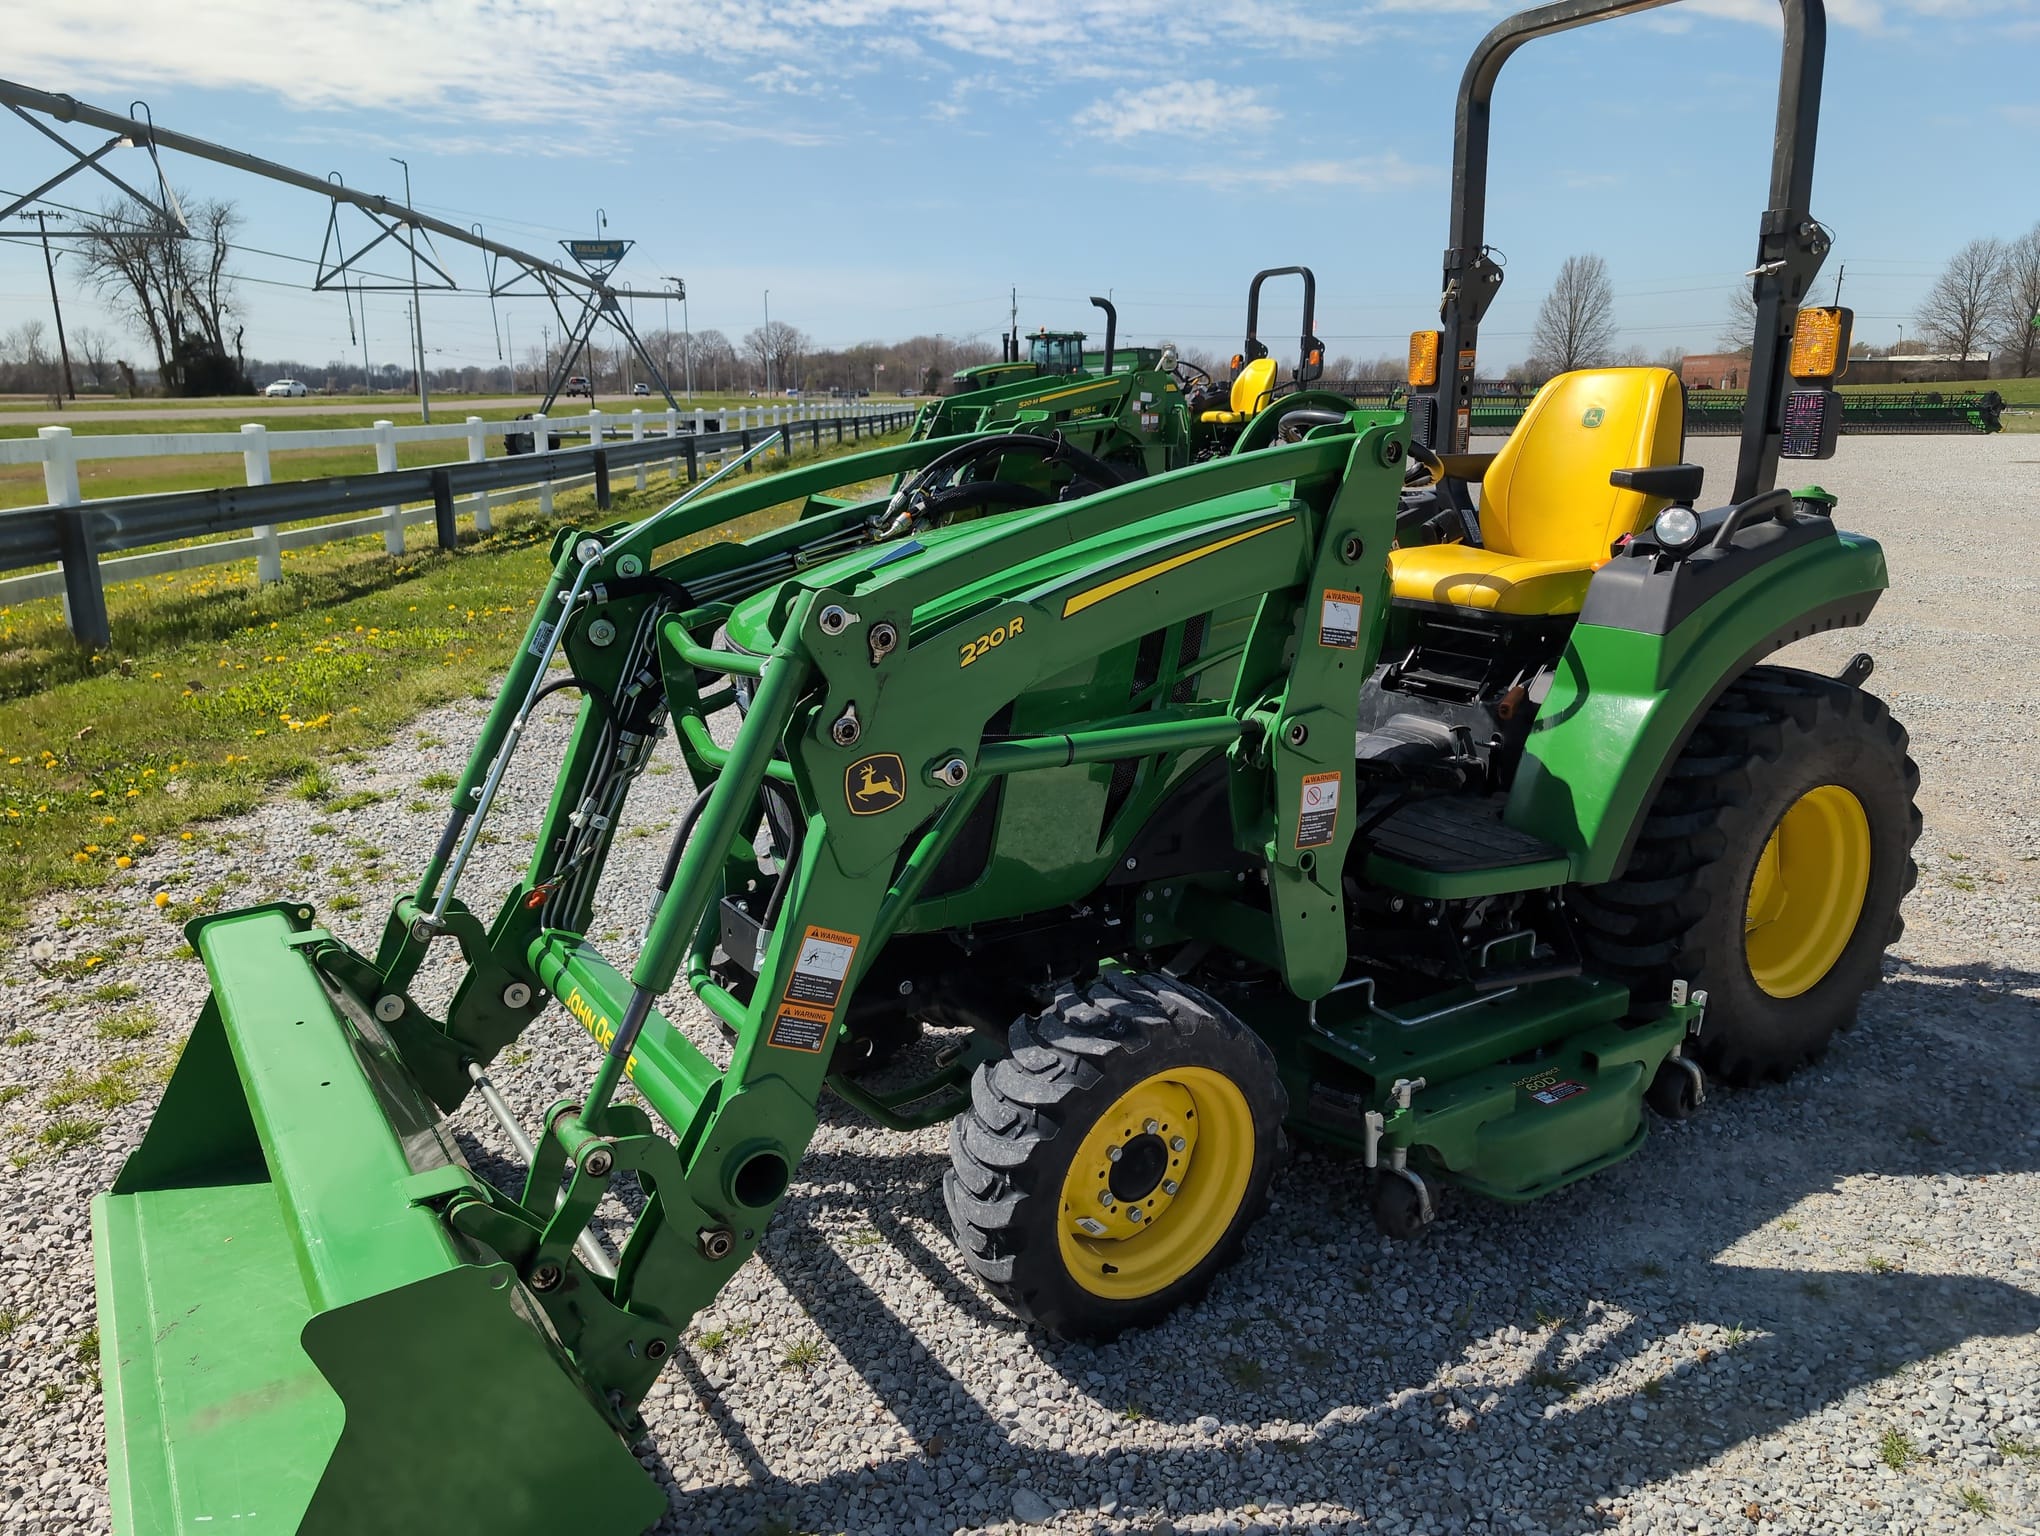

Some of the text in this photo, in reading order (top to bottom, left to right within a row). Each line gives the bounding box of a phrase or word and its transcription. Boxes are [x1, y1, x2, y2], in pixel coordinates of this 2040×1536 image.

[1331, 592, 1360, 604] WARNING
[959, 615, 1025, 669] 220 R
[1310, 772, 1339, 783] WARNING
[819, 931, 853, 944] WARNING
[793, 1009, 826, 1021] WARNING
[565, 987, 638, 1080] JOHN DEE
[1512, 1065, 1561, 1087] toConnect
[1526, 1077, 1557, 1091] 60D
